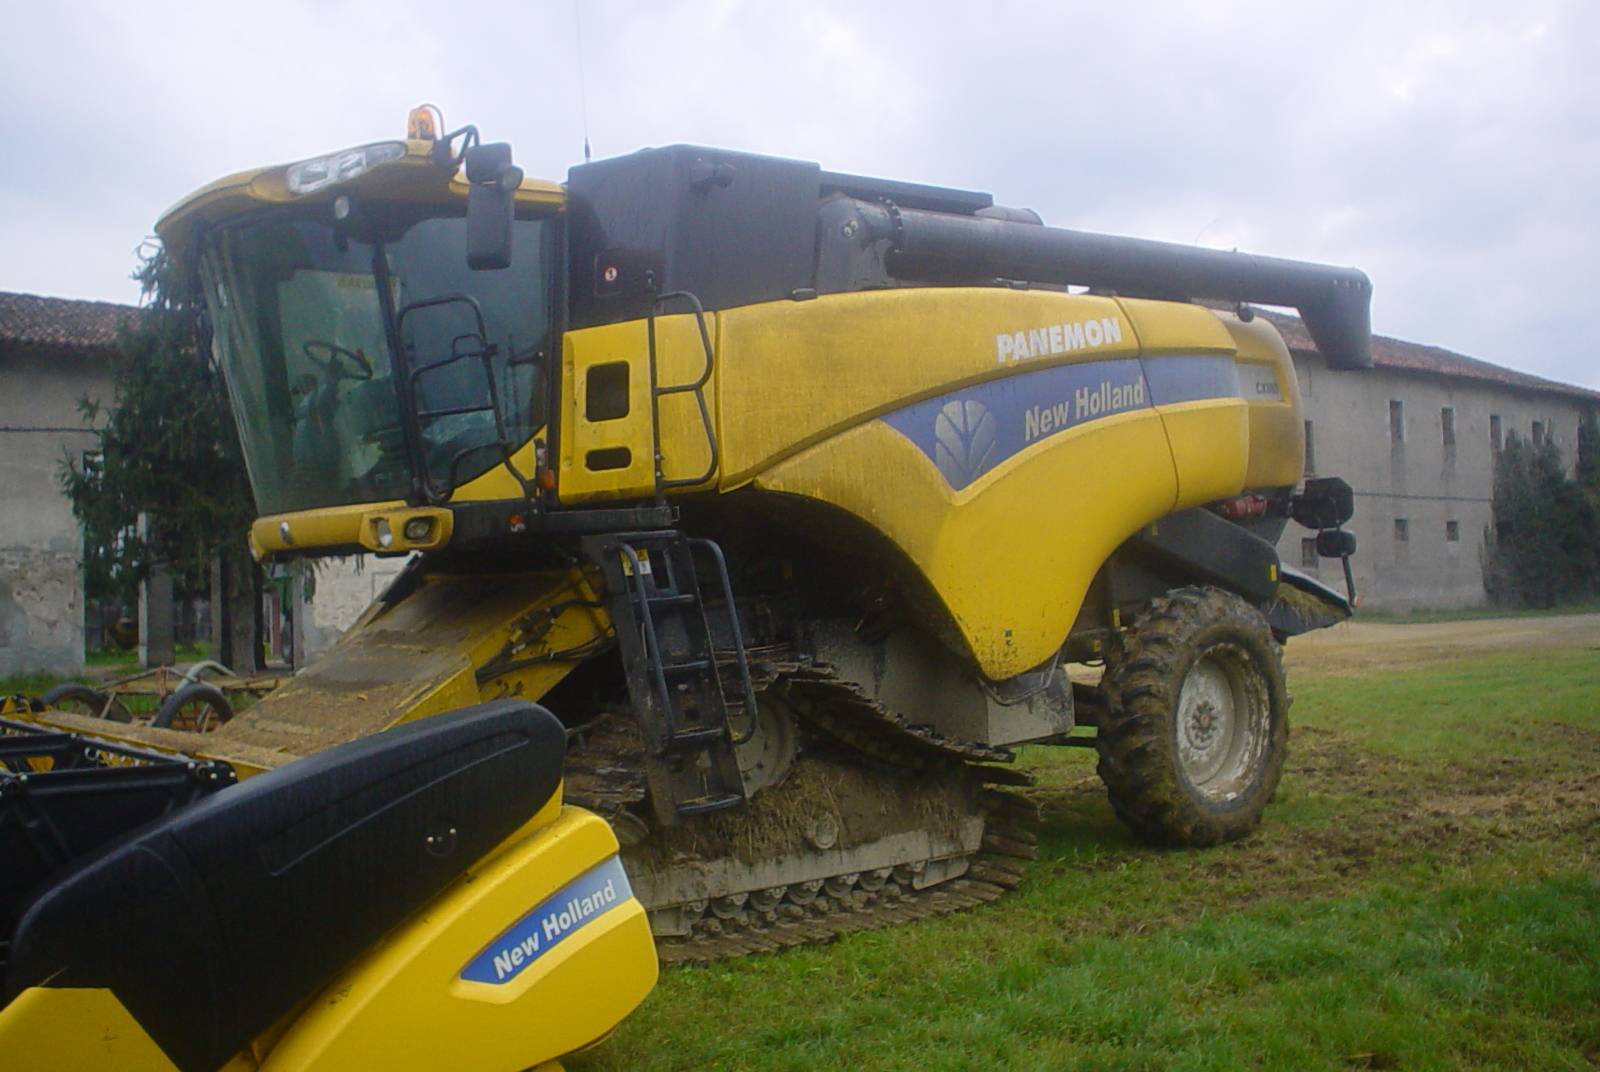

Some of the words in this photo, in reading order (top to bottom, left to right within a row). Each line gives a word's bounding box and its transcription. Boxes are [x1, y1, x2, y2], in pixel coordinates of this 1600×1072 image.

[996, 317, 1122, 362] PANEMON
[1024, 400, 1069, 441] New
[1075, 375, 1145, 419] Holland
[493, 932, 540, 979] New
[541, 879, 616, 941] Holland
